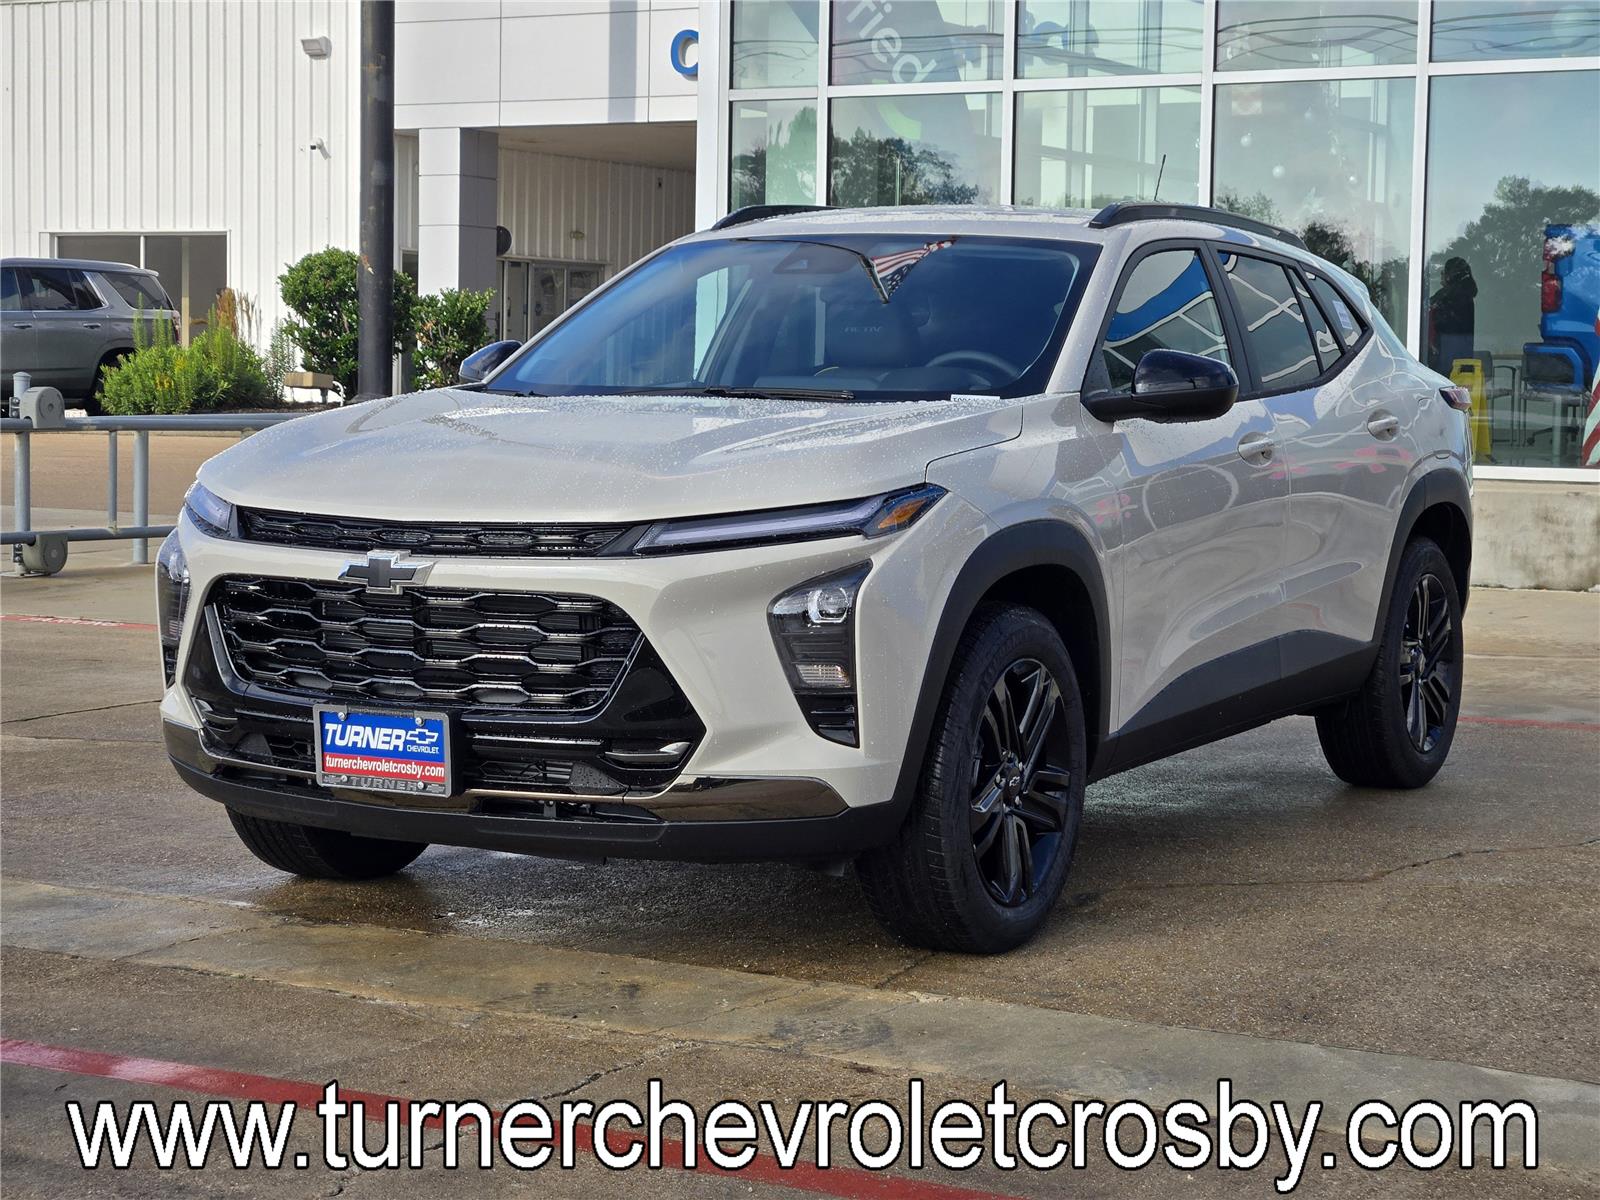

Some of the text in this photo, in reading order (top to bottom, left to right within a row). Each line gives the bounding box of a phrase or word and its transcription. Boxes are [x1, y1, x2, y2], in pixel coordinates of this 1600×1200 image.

[324, 723, 408, 751] TURNER
[406, 744, 439, 754] CHEVROLET
[325, 755, 445, 778] turnerchevroletcrosby.com
[350, 776, 419, 792] TURNER
